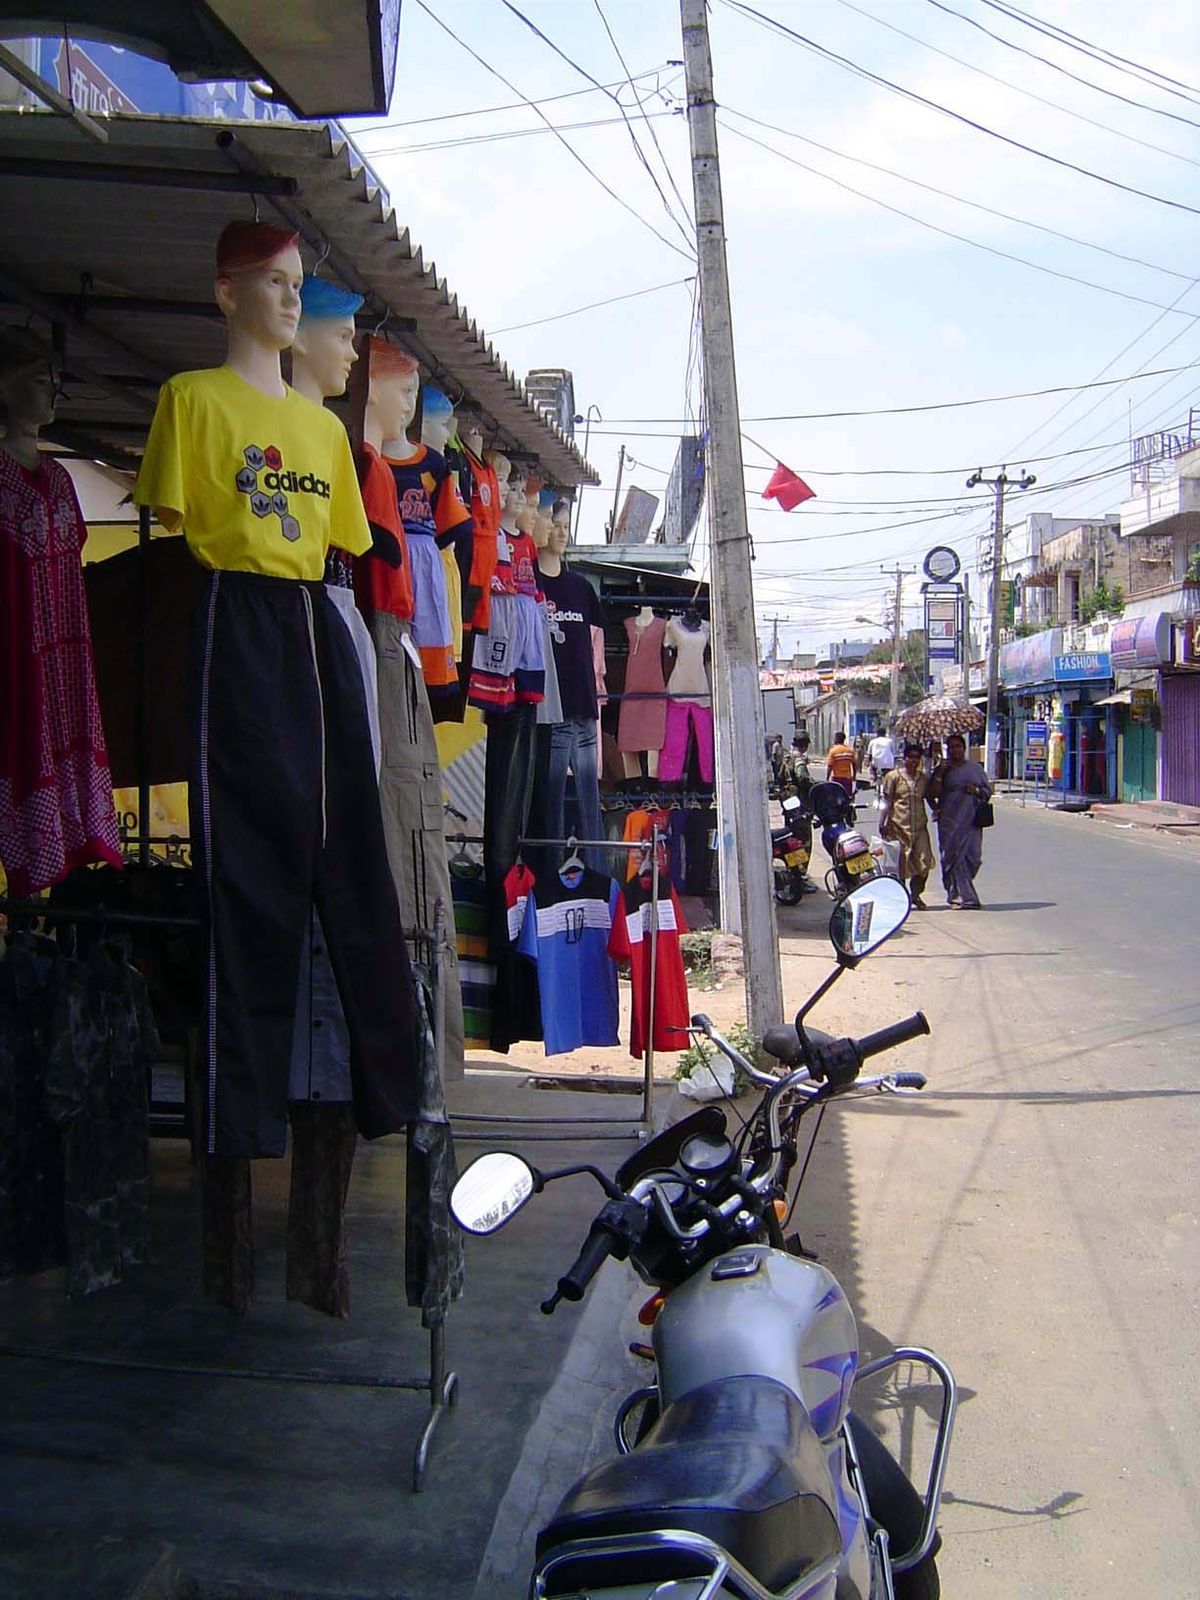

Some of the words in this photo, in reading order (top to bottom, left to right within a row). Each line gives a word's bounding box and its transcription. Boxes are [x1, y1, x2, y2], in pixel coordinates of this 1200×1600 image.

[547, 610, 584, 622] adidas
[491, 641, 506, 662] 9
[1059, 655, 1098, 671] FASHION
